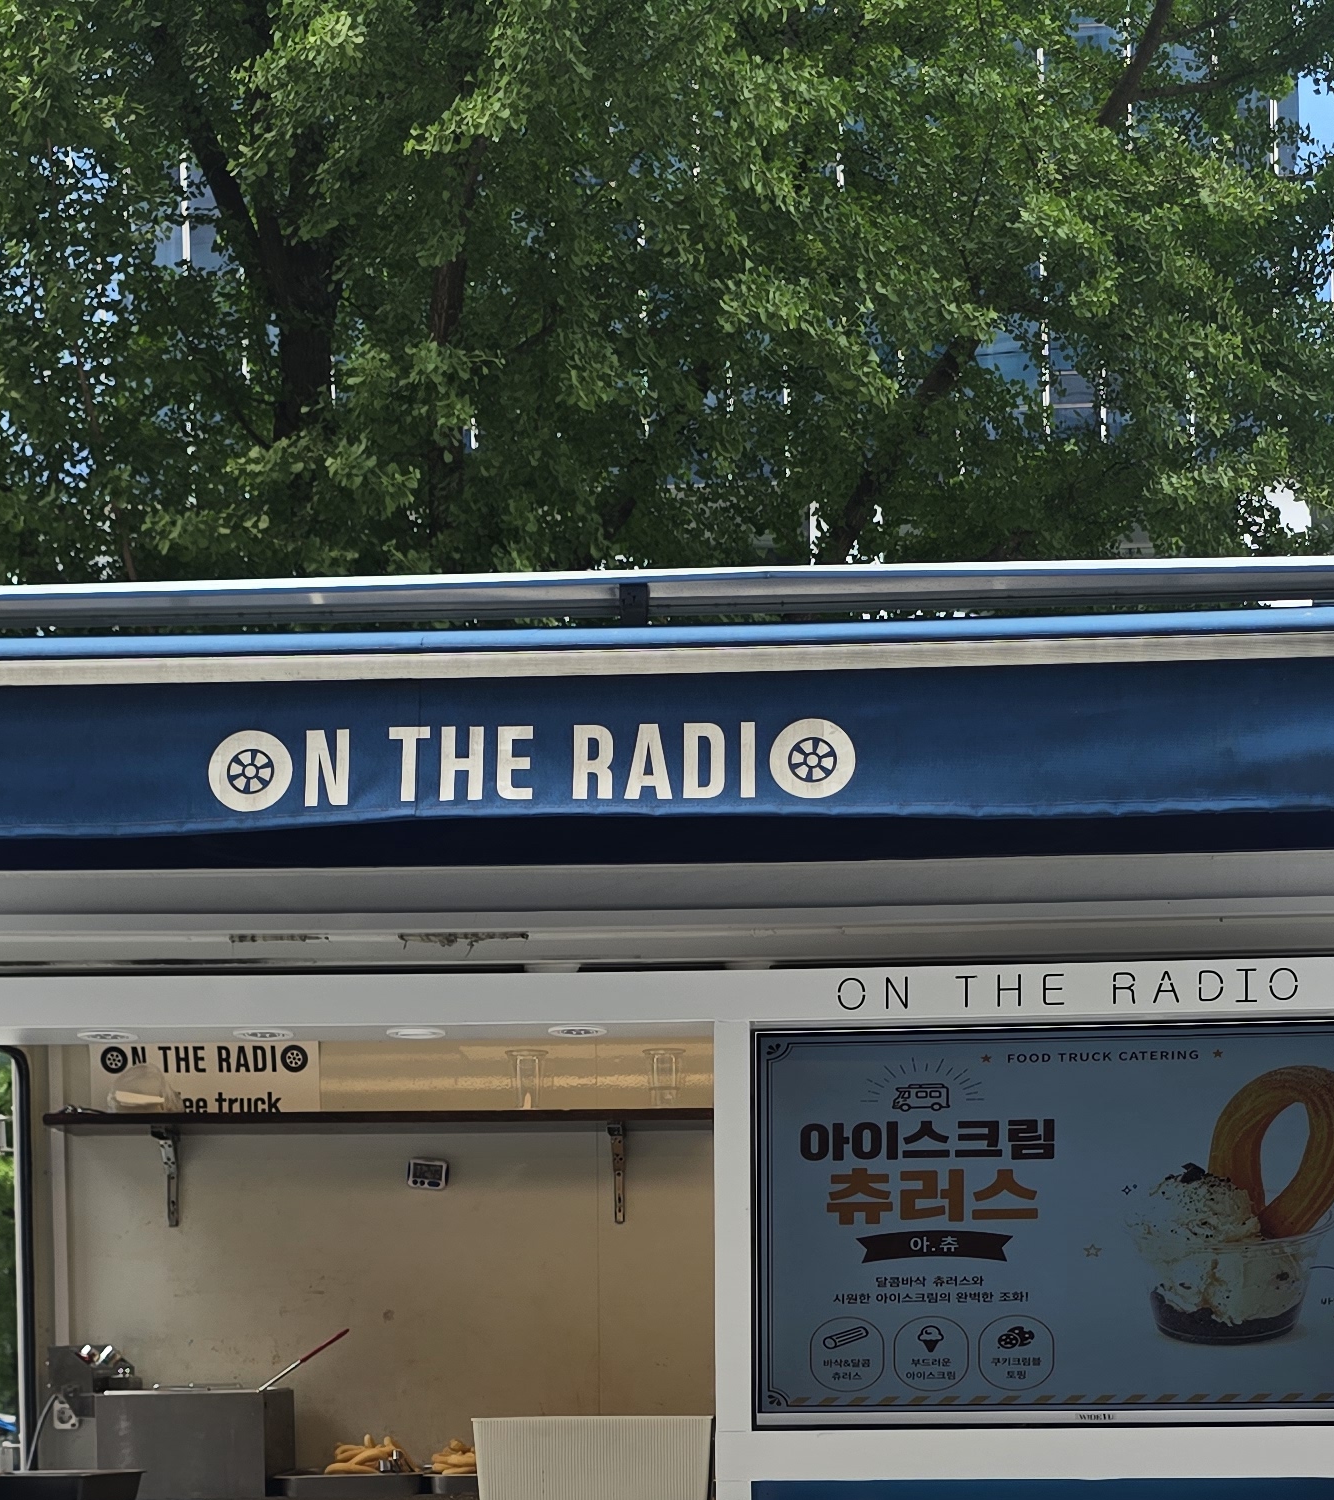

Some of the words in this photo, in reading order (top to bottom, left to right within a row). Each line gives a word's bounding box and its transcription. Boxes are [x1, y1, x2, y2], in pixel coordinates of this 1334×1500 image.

[208, 729, 351, 812] ON
[388, 725, 534, 802] THE
[572, 718, 856, 799] RADIO
[837, 976, 909, 1011] ON
[955, 973, 1065, 1008] THE
[1112, 967, 1299, 1004] RADIO
[157, 1045, 207, 1074] THE
[216, 1043, 309, 1073] RADIO
[1006, 1053, 1051, 1064] FOOD
[1058, 1051, 1113, 1063] TRUCK
[1118, 1049, 1200, 1062] CATERING
[215, 1091, 283, 1113] truck
[799, 1118, 1056, 1162] 아이스크림
[826, 1168, 1039, 1226] 츄러스
[909, 1235, 959, 1254] 아.츄
[875, 1275, 927, 1288] 달콤바삭
[933, 1275, 984, 1288] 츄러스와
[833, 1293, 870, 1304] 시원한
[875, 1292, 951, 1304] 아이스크림의
[956, 1291, 994, 1303] 완벽한
[999, 1291, 1029, 1303] 조화!
[910, 1357, 952, 1368] 부드러운
[831, 1371, 863, 1382] 츄러스
[905, 1371, 956, 1381] 아이스크림
[1005, 1370, 1027, 1380] 토핑
